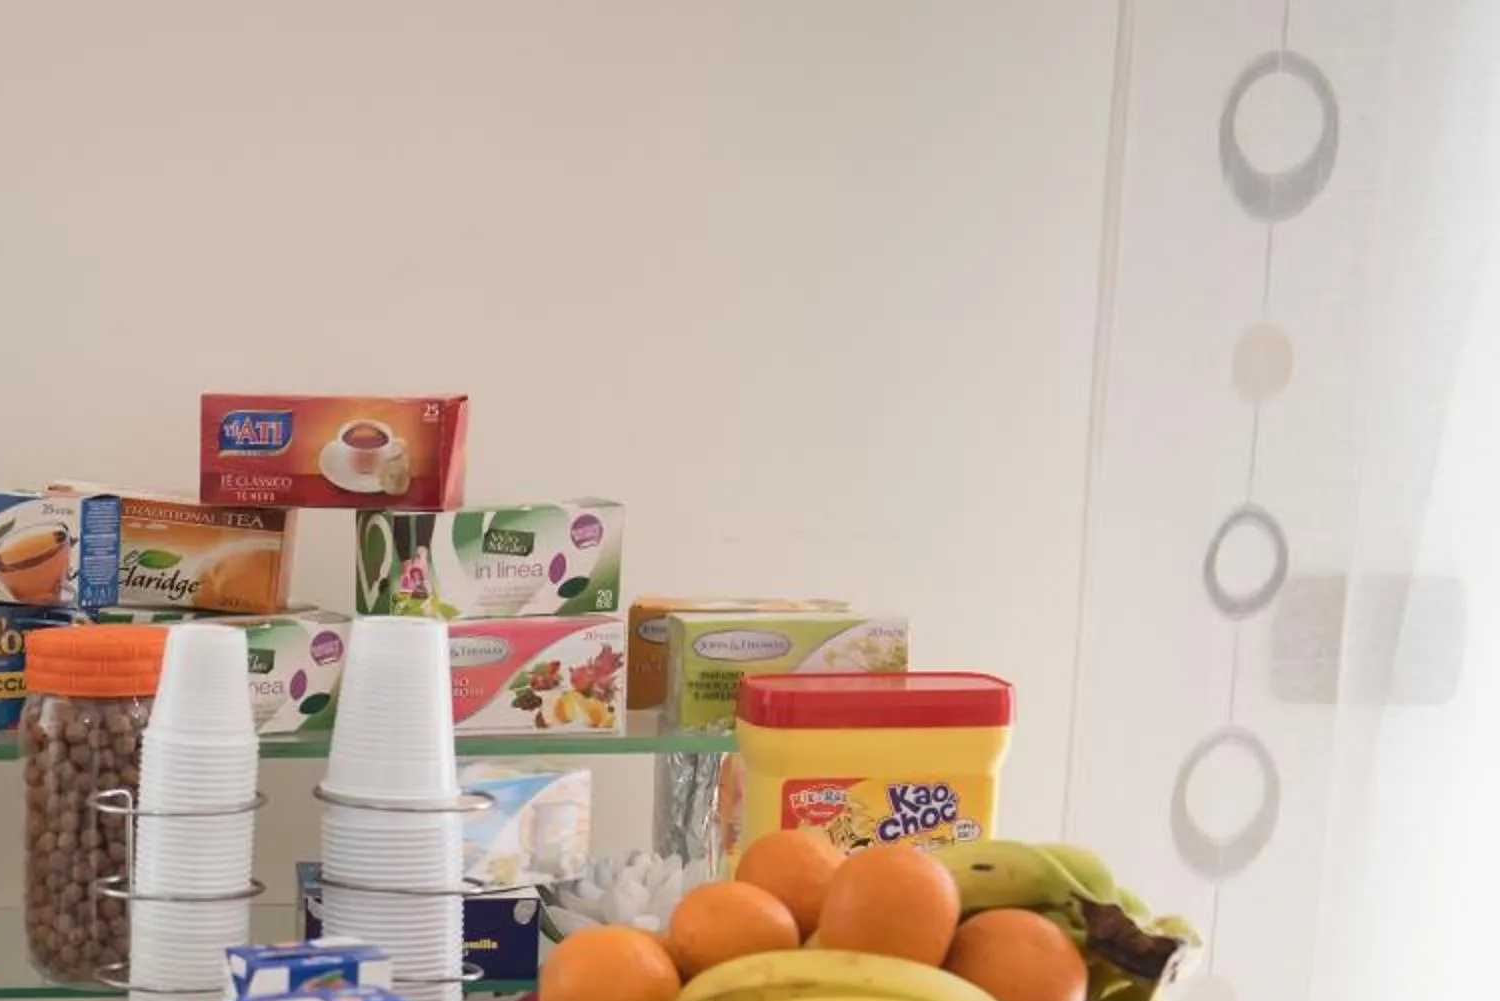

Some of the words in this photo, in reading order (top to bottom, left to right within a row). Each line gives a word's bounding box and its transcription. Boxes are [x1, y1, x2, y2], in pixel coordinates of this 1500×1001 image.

[424, 403, 440, 418] 25
[124, 504, 217, 525] TRADITIONAL
[226, 512, 264, 529] TEA
[474, 562, 492, 580] in
[497, 561, 544, 579] linea
[596, 588, 614, 601] 20
[248, 681, 285, 696] nea
[886, 783, 950, 814] Kao
